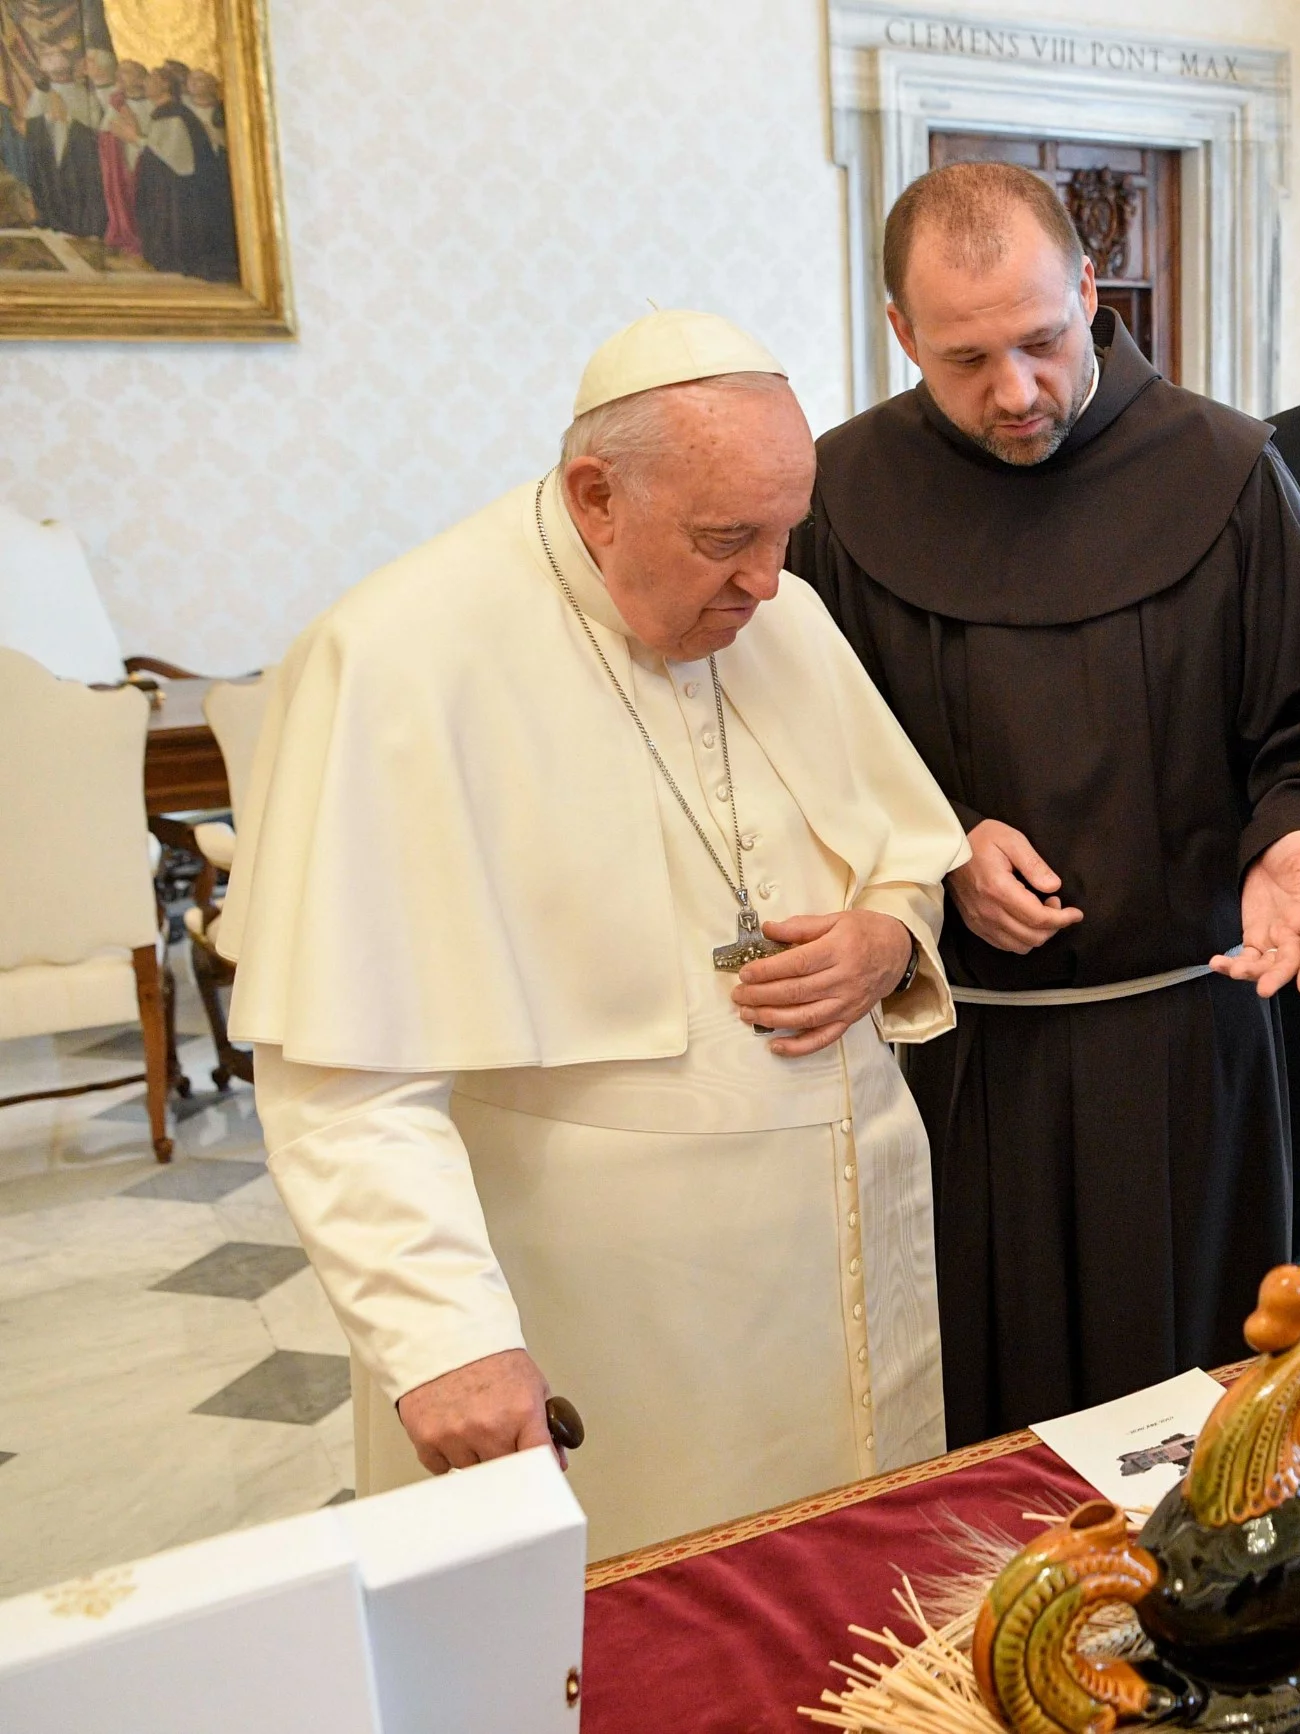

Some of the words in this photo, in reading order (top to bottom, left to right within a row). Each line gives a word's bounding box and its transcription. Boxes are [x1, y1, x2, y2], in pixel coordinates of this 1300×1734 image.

[884, 18, 1020, 58] CLEMENS
[1030, 34, 1075, 64] VIII
[1090, 39, 1164, 73] PONT
[1179, 51, 1239, 81] MAX
